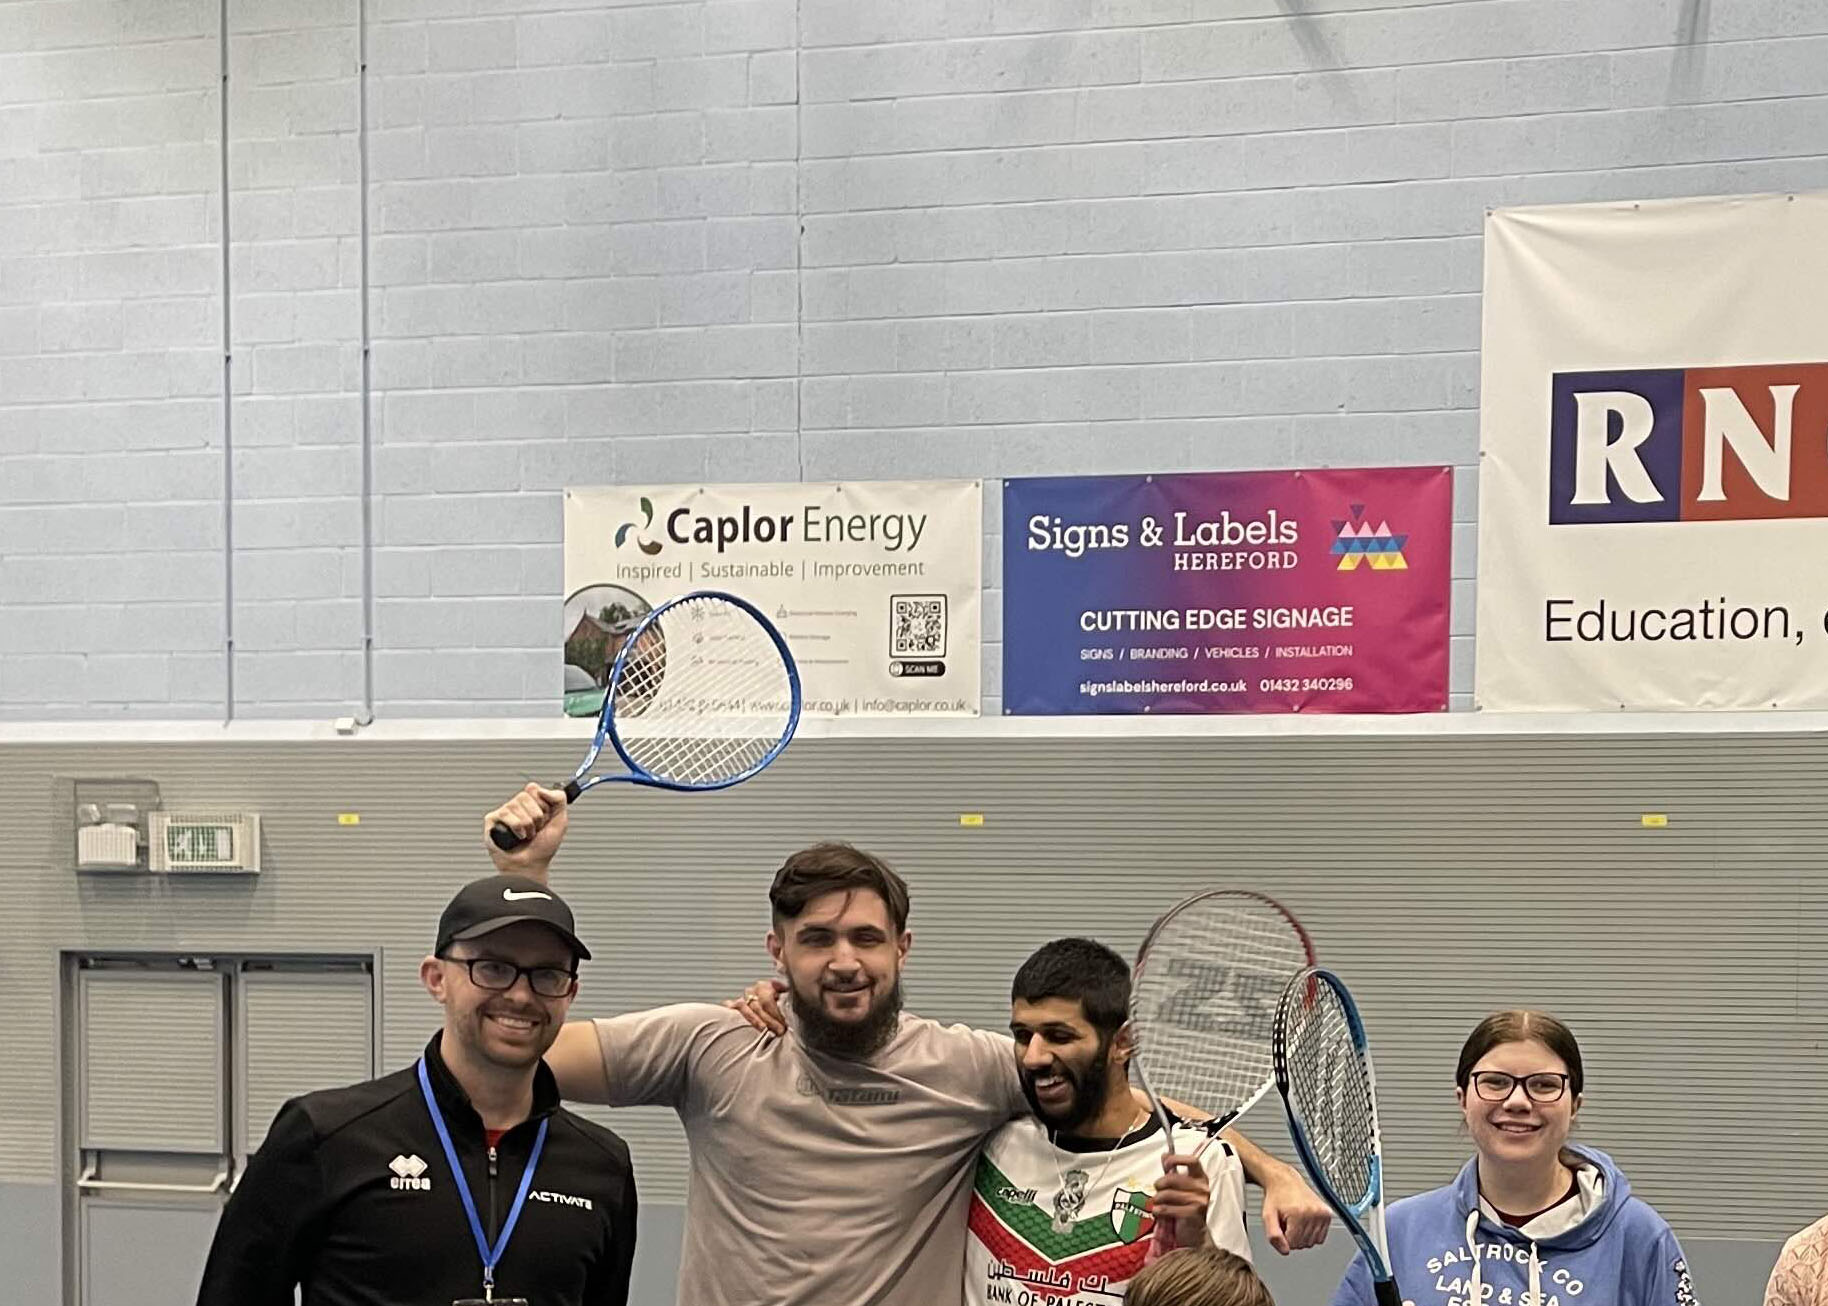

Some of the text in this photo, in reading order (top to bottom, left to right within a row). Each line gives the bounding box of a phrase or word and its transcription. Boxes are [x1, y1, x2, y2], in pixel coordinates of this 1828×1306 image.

[666, 505, 927, 554] Caplor Energy
[1028, 509, 1298, 557] Signs & Labels
[616, 560, 926, 580] Inspired Sustainable Improvement
[1174, 550, 1299, 572] HEREFORD
[1080, 607, 1354, 632] CUTTING EDGE SIGNAGE
[1546, 597, 1805, 647] Education,
[1080, 644, 1354, 661] SIGNS BRANDING VEHICLES INSTALLATION
[1080, 678, 1354, 696] signslabelshereford.co.uk 01432 340296
[987, 1283, 1013, 1305] BANK
[1435, 1274, 1494, 1300] LAND
[1499, 1287, 1513, 1305] &
[1552, 1268, 1584, 1296] CO
